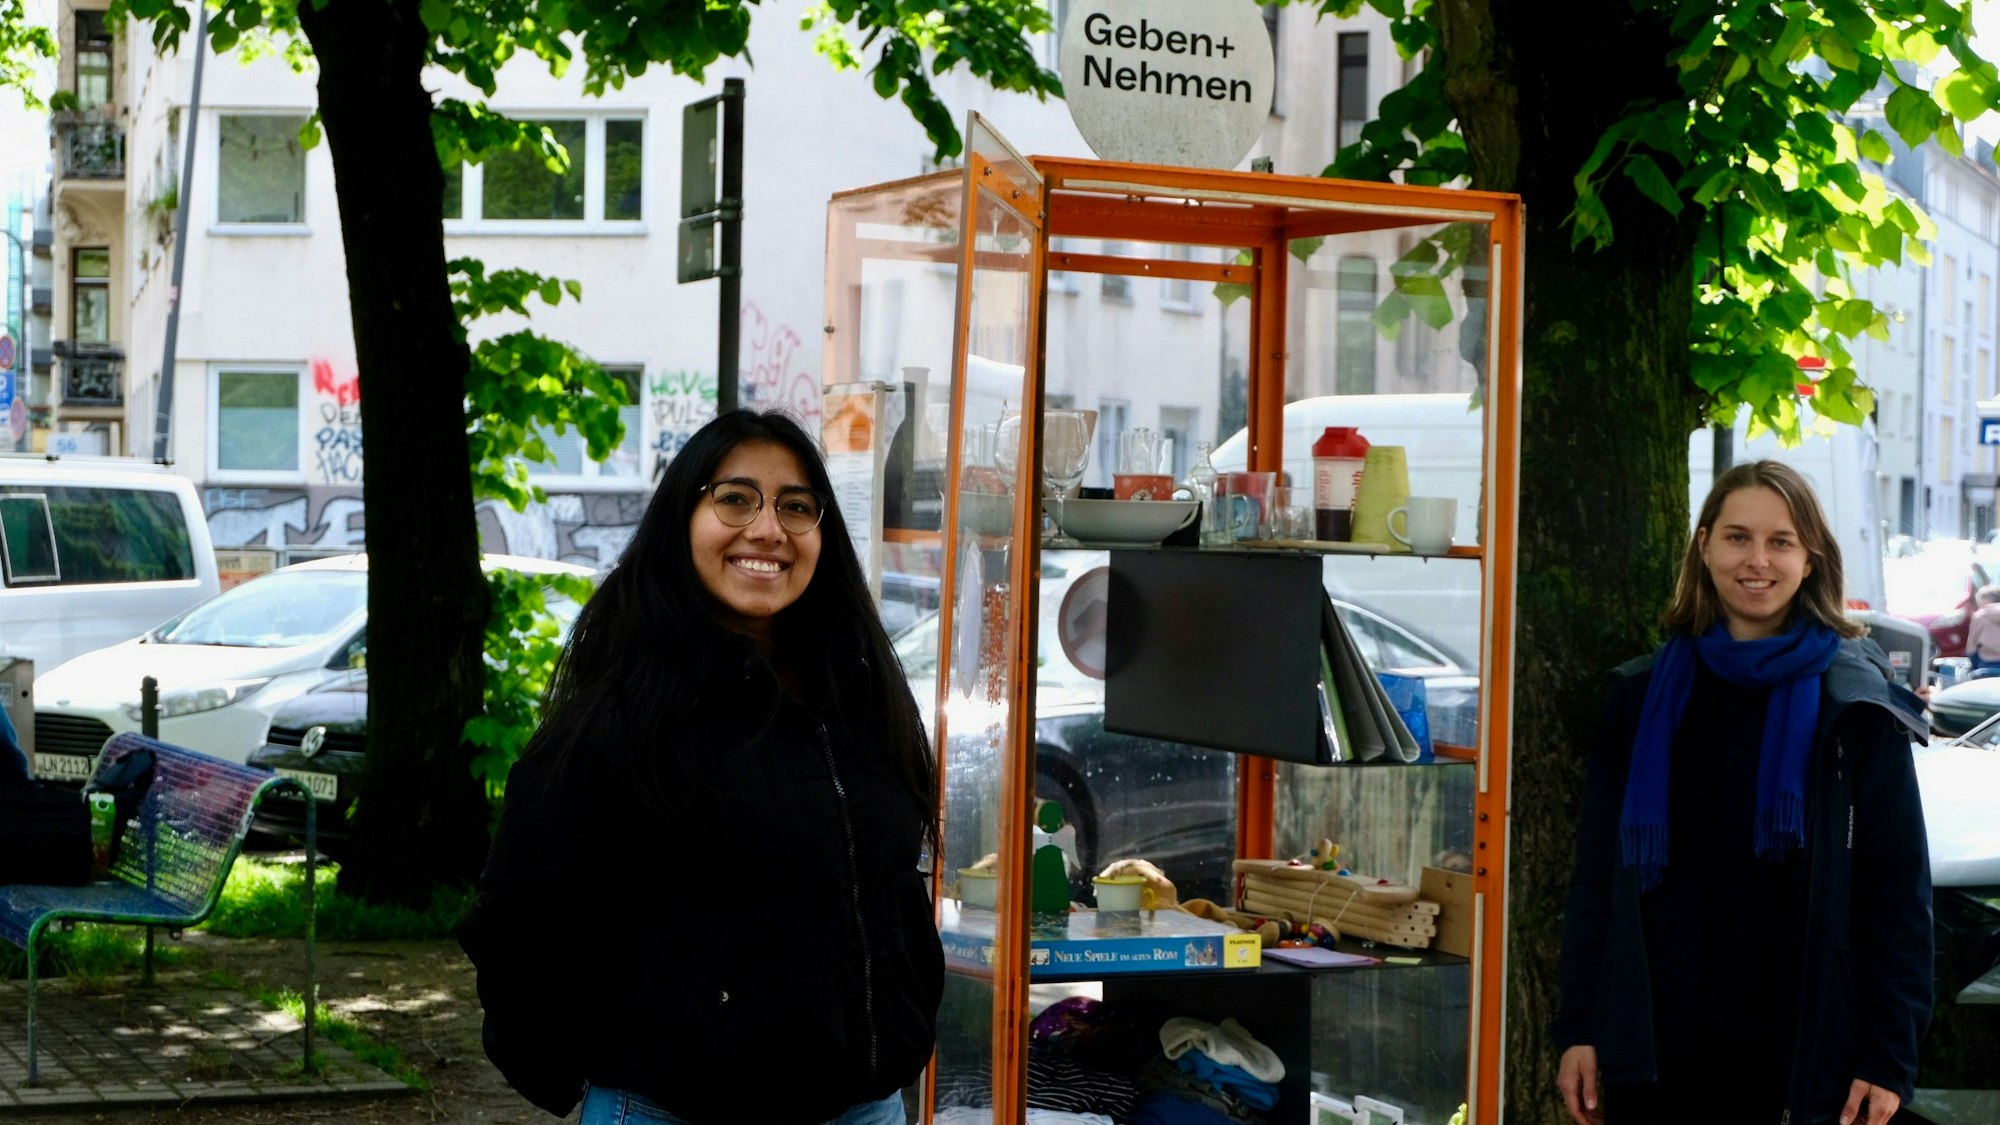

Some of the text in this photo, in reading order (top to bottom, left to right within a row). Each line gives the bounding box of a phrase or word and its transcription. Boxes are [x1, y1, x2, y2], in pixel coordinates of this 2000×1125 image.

[1084, 12, 1235, 58] Geben+
[1083, 54, 1252, 103] Nehmen
[61, 757, 88, 775] 2112
[1054, 951, 1083, 963] NEUE
[1084, 949, 1118, 962] SPIELE
[1153, 948, 1178, 960] ROM
